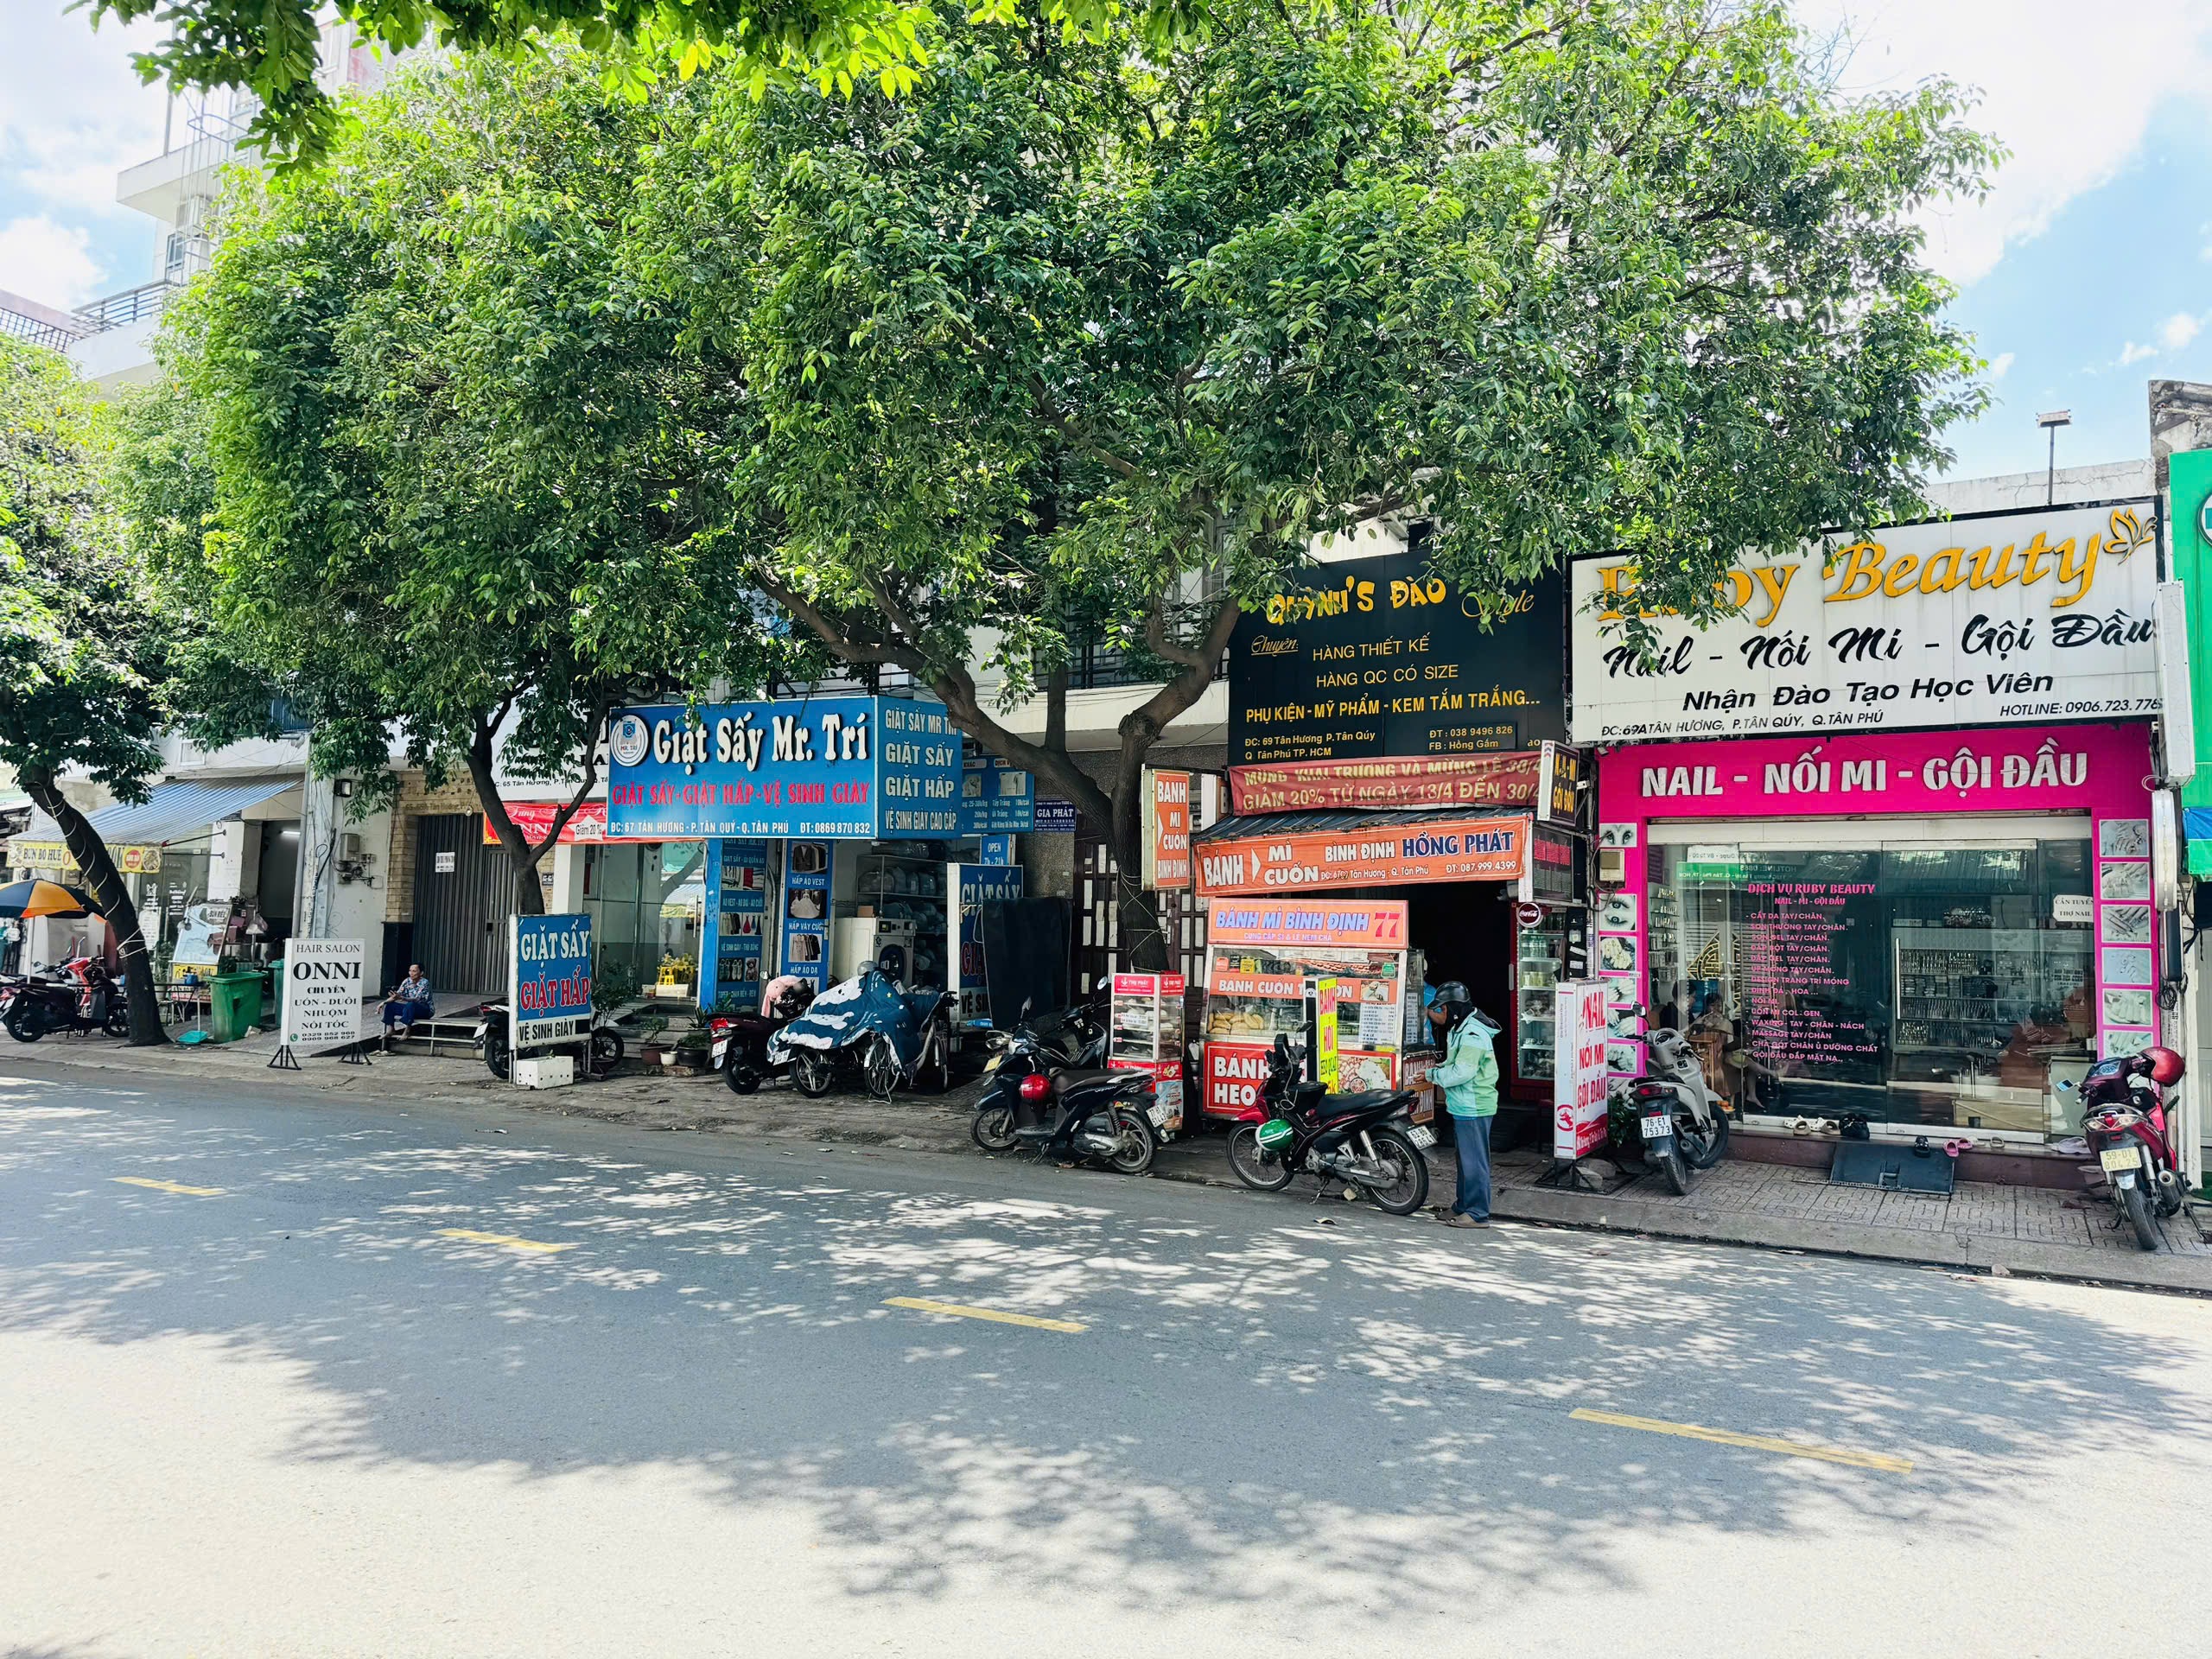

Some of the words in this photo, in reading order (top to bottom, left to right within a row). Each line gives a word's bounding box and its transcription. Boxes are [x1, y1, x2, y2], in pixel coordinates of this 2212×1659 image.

[1823, 531, 2101, 607] Beauty
[1389, 575, 1446, 609] ĐÀO
[1313, 645, 1355, 661] HÀNG
[1358, 635, 1403, 657] THIẾT
[1408, 632, 1431, 652] KẾ
[1739, 630, 1812, 671] Nối
[1828, 626, 1903, 664] Mi
[1961, 613, 2036, 661] Gội
[2050, 608, 2156, 648] Đầu
[1316, 671, 1358, 688] HÀNG
[1363, 670, 1387, 684] QC
[1393, 664, 1417, 682] CÓ
[1424, 664, 1459, 680] SIZE
[1246, 708, 1272, 725] PHỤ
[1274, 702, 1306, 722] KIỆN
[1314, 699, 1335, 719] MỸ
[1339, 692, 1380, 716] PHẨM
[1392, 696, 1425, 713] KEM
[1429, 687, 1464, 711] TẮM
[1682, 689, 1756, 714] Nhận
[1772, 683, 1831, 706] Đào
[1846, 681, 1900, 707] Tạo
[1910, 677, 1974, 702] Học
[1986, 671, 2054, 695] Viên
[885, 707, 906, 734] GIẶT
[908, 706, 925, 733] SẤY
[928, 715, 942, 734] MR
[1858, 710, 1884, 723] PHÚ
[1999, 702, 2063, 717] HOTLINE:
[716, 711, 764, 772] Sấy
[772, 715, 813, 761] Mr.
[822, 712, 868, 760] Trí
[1262, 737, 1273, 746] 69
[1275, 736, 1291, 745] Tân
[1293, 734, 1323, 745] Hương
[1450, 728, 1467, 737] 038
[1470, 726, 1493, 736] 9496
[1496, 725, 1513, 734] 826
[885, 741, 920, 768] GIẶT
[925, 741, 954, 767] SẤY
[1273, 748, 1291, 759] Phú
[1310, 747, 1332, 757] HCM
[1449, 740, 1474, 751] Hồng
[1400, 759, 1421, 776] VÀ
[1643, 766, 1724, 798] NAIL
[1763, 744, 1834, 795] NỐI
[1840, 760, 1888, 792] MI
[1923, 747, 1993, 798] GỘI
[1999, 736, 2088, 788] ĐẦU
[612, 781, 645, 809] GIẶT
[683, 779, 718, 809] GIẶT
[722, 778, 754, 805] HẤP
[763, 779, 782, 809] VỆ
[788, 782, 825, 804] SINH
[832, 778, 870, 804] GIÀY
[885, 773, 920, 801] GIẶT
[925, 773, 954, 798] HẤP
[1157, 776, 1186, 804] BÁNH
[1243, 786, 1286, 810] GIẢM
[1290, 787, 1325, 805] 20%
[1330, 783, 1356, 803] TỪ
[1417, 781, 1453, 800] 13/4
[1459, 774, 1500, 799] ĐẾN
[885, 806, 894, 834] VỆ
[896, 810, 912, 830] SINH
[913, 808, 928, 830] GIÀY
[931, 810, 943, 830] CAO
[944, 805, 957, 830] CẤP
[1037, 809, 1051, 817] GIA
[1052, 806, 1074, 817] PHÁT
[1169, 808, 1181, 828] MÌ
[772, 819, 789, 834] PHÚ
[837, 822, 852, 834] 870
[855, 822, 870, 834] 832
[988, 842, 1001, 853] OPEN
[1268, 840, 1293, 862] MÌ
[1324, 842, 1357, 862] BÌNH
[1360, 841, 1395, 863] ĐỊNH
[1402, 830, 1459, 859] HỒNG
[1464, 828, 1516, 854] PHÁT
[1203, 848, 1244, 887] BÁNH
[1264, 861, 1319, 887] CUỐN
[1401, 867, 1414, 876] Tân
[1415, 865, 1429, 875] Phú
[1460, 861, 1516, 873] 087.999.4399
[1777, 884, 1793, 895] VỤ
[1796, 883, 1826, 894] RUBY
[1829, 883, 1876, 894] BEAUTY
[1815, 897, 1827, 906] GỘI
[1216, 906, 1260, 929] BÁNH
[1261, 906, 1282, 930] MÌ
[1284, 906, 1325, 931] BÌNH
[1326, 912, 1370, 937] ĐỊNH
[1374, 912, 1402, 940] 77
[296, 944, 322, 953] HAIR
[325, 944, 360, 953] SALON
[520, 924, 558, 968] GIẶT
[561, 918, 590, 959] SẤY
[293, 962, 361, 981] ONNI
[1823, 977, 1850, 986] MÓNG
[520, 971, 558, 1017] GIẶT
[560, 965, 591, 1007] HẤP
[1582, 991, 1606, 1030] NAIL
[519, 1022, 530, 1045] VỆ
[532, 1023, 553, 1040] SINH
[555, 1018, 575, 1038] GIÀY
[1809, 1020, 1834, 1028] CHÂN
[1840, 1020, 1865, 1030] NÁCH
[1579, 1038, 1592, 1071] NỐI
[1593, 1042, 1605, 1065] MI
[1789, 1041, 1814, 1050] CHÂN
[1213, 1052, 1273, 1080] BÁNH
[1213, 1082, 1257, 1107] HEO
[1577, 1078, 1589, 1113] GỘI
[1590, 1071, 1606, 1103] ĐẦU
